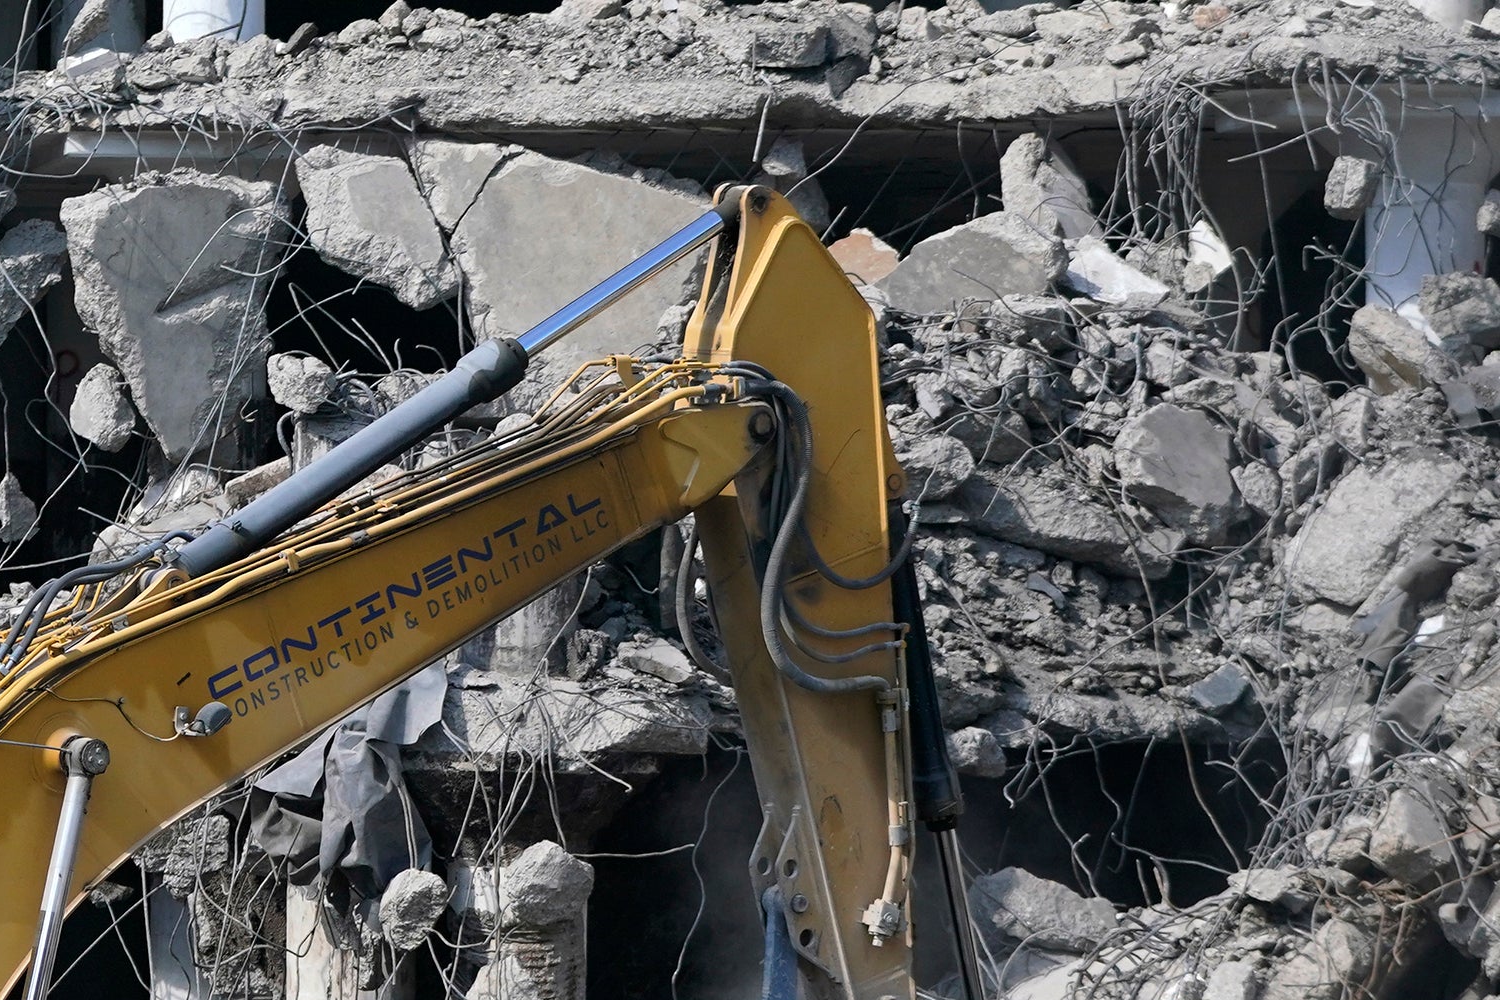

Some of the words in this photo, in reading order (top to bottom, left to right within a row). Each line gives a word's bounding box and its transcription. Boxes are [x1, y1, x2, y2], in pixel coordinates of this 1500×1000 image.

[208, 494, 601, 700] CONTINENTAL
[234, 622, 395, 718] ONSTRUCTION
[404, 610, 419, 629] &
[426, 534, 563, 619] DEMOLITION
[570, 509, 610, 543] LLC
